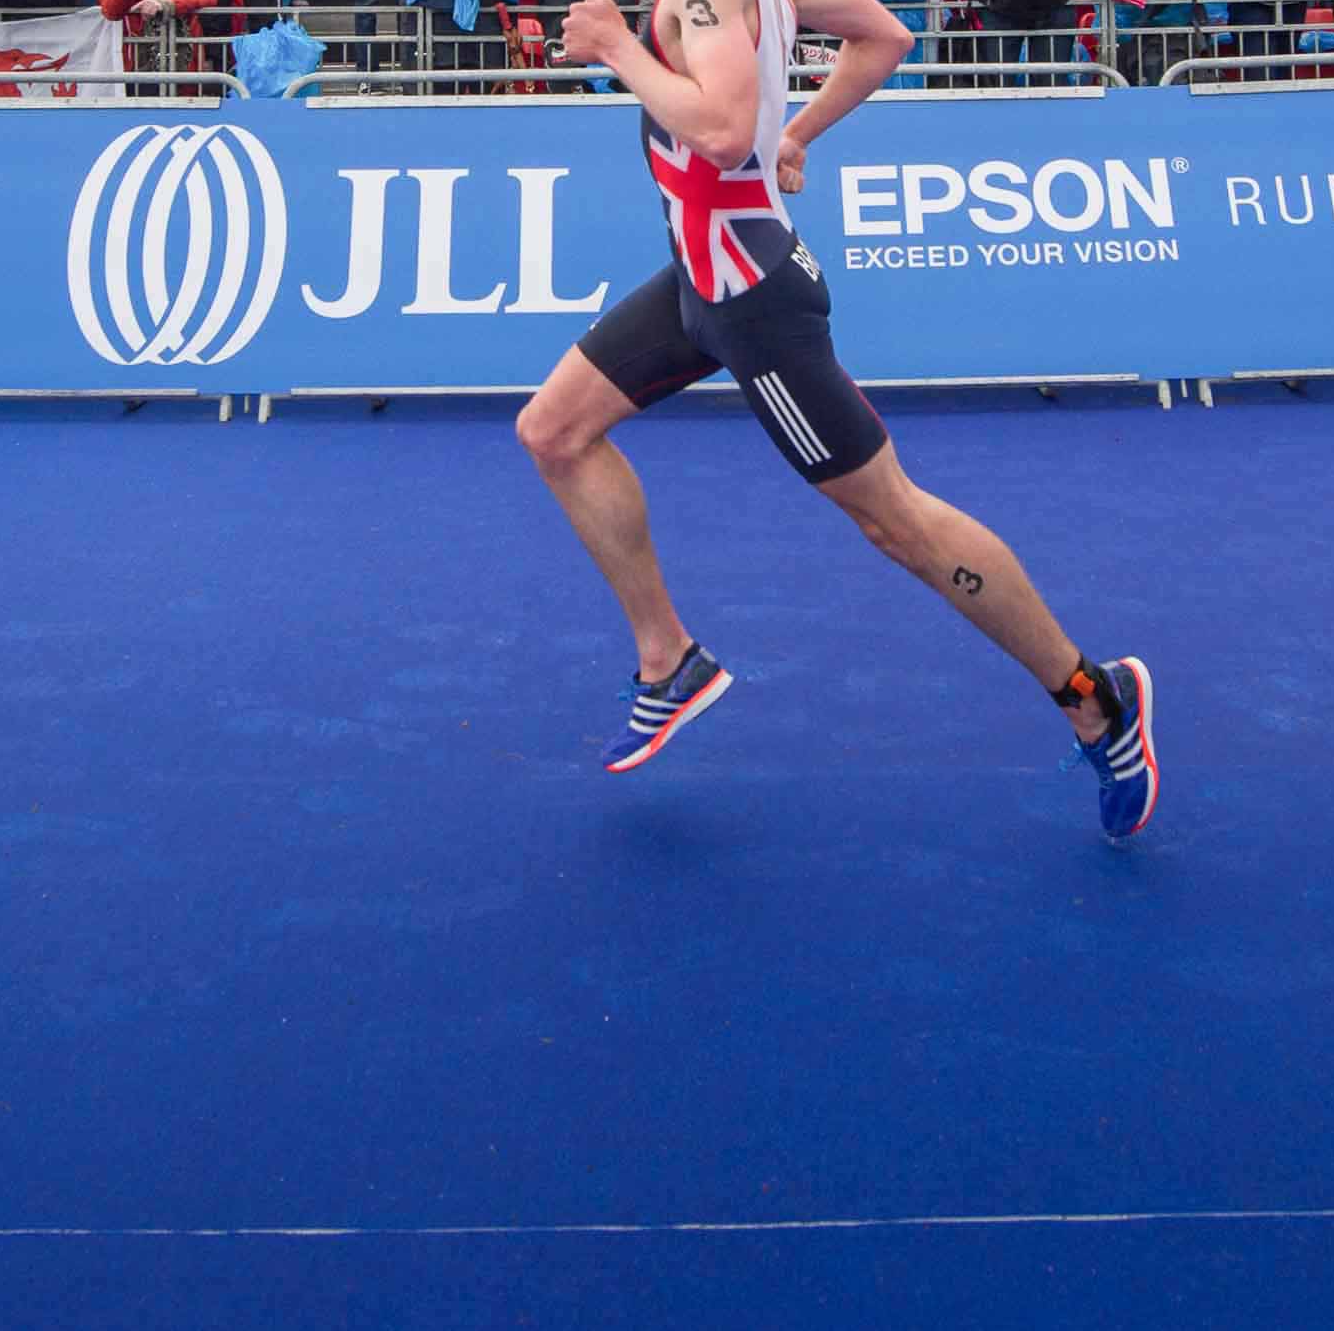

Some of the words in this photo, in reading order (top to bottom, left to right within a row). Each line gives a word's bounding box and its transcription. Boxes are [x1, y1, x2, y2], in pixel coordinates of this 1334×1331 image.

[300, 168, 610, 319] JLL
[844, 245, 969, 270] EXCEED
[977, 242, 1065, 266] YOUR
[1073, 239, 1180, 263] VISION
[953, 565, 983, 595] 3
